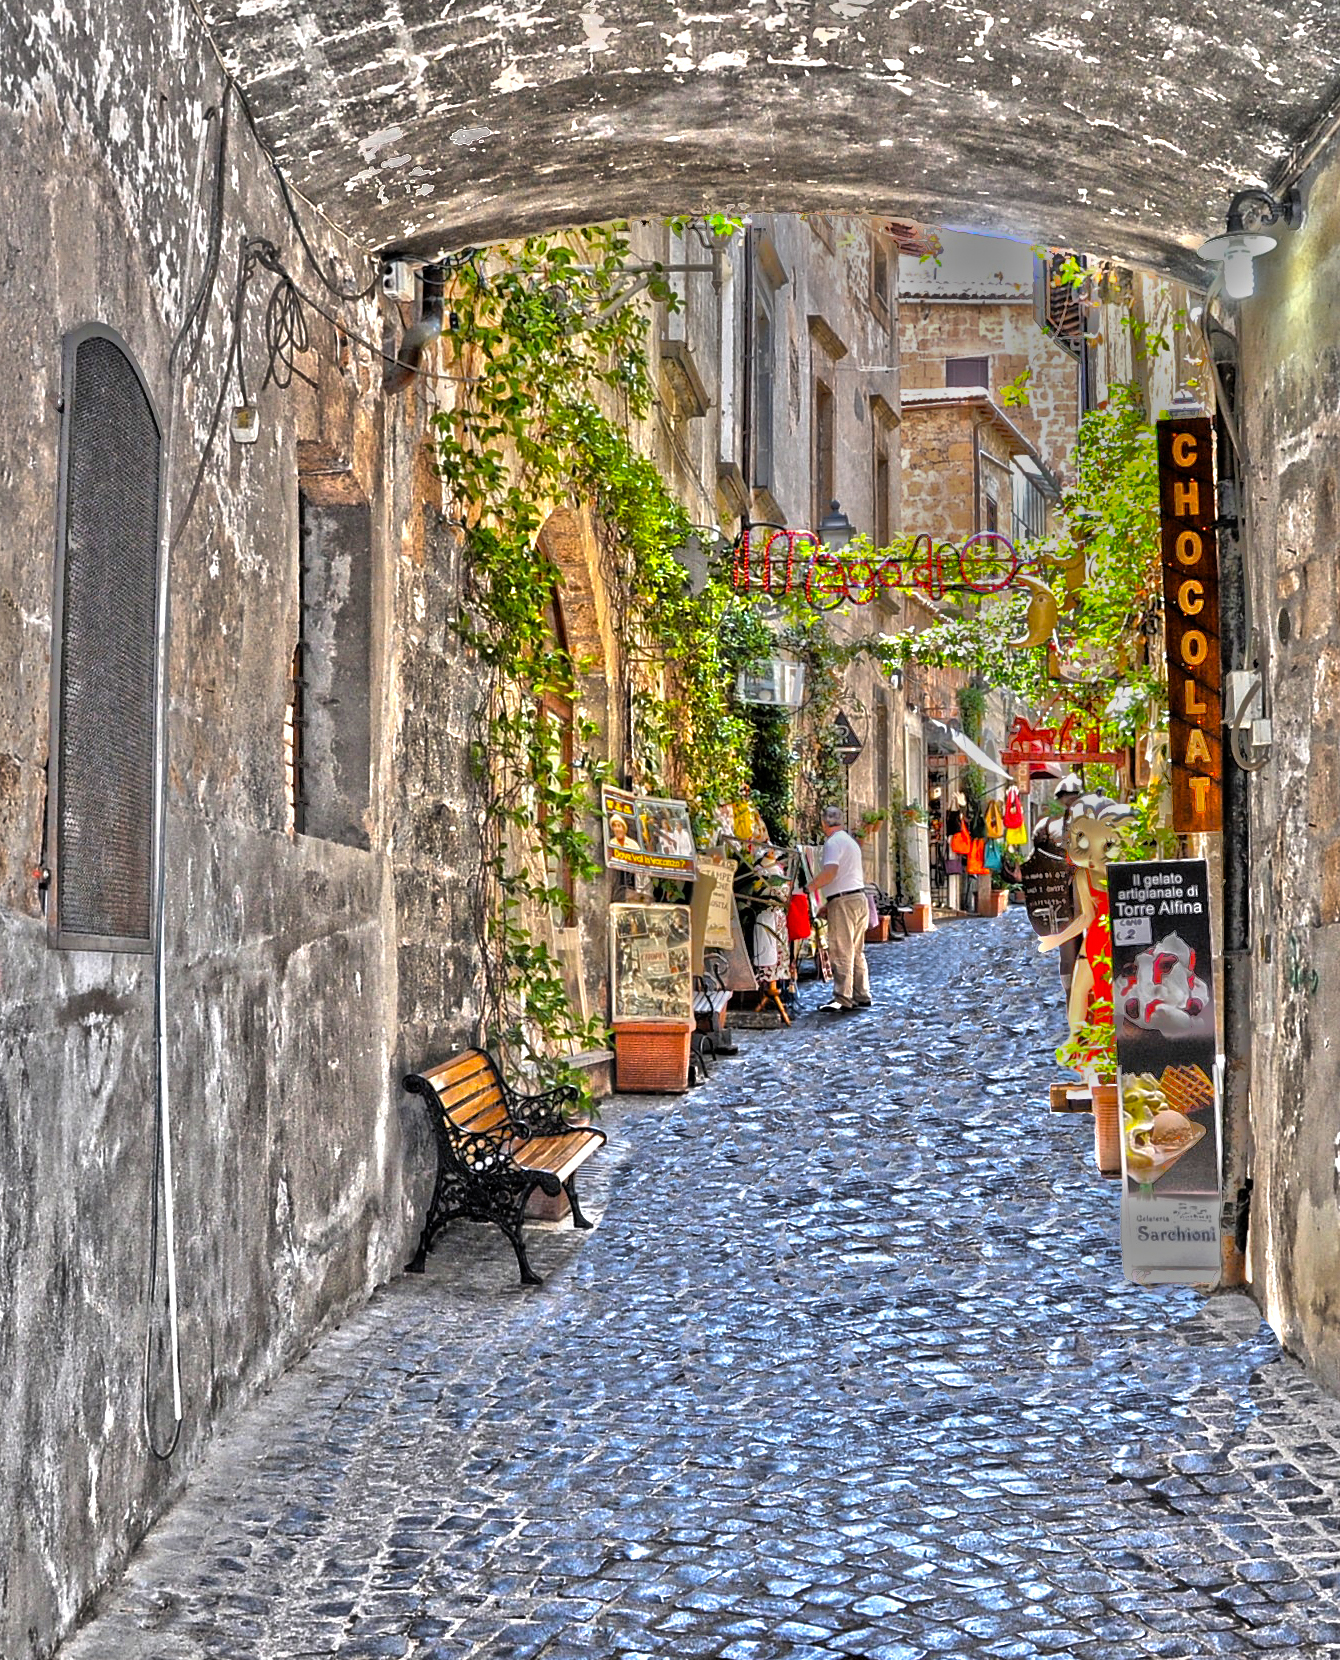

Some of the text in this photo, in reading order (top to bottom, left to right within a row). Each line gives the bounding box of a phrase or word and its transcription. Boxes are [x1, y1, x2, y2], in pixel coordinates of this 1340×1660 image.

[1171, 432, 1213, 814] CHOCOLAT
[1143, 872, 1184, 888] gelato
[1117, 885, 1199, 902] artigianale di
[1115, 900, 1203, 917] Torre Alfina
[1136, 1214, 1170, 1222] Gelateria
[1137, 1225, 1217, 1242] Sarchioni
